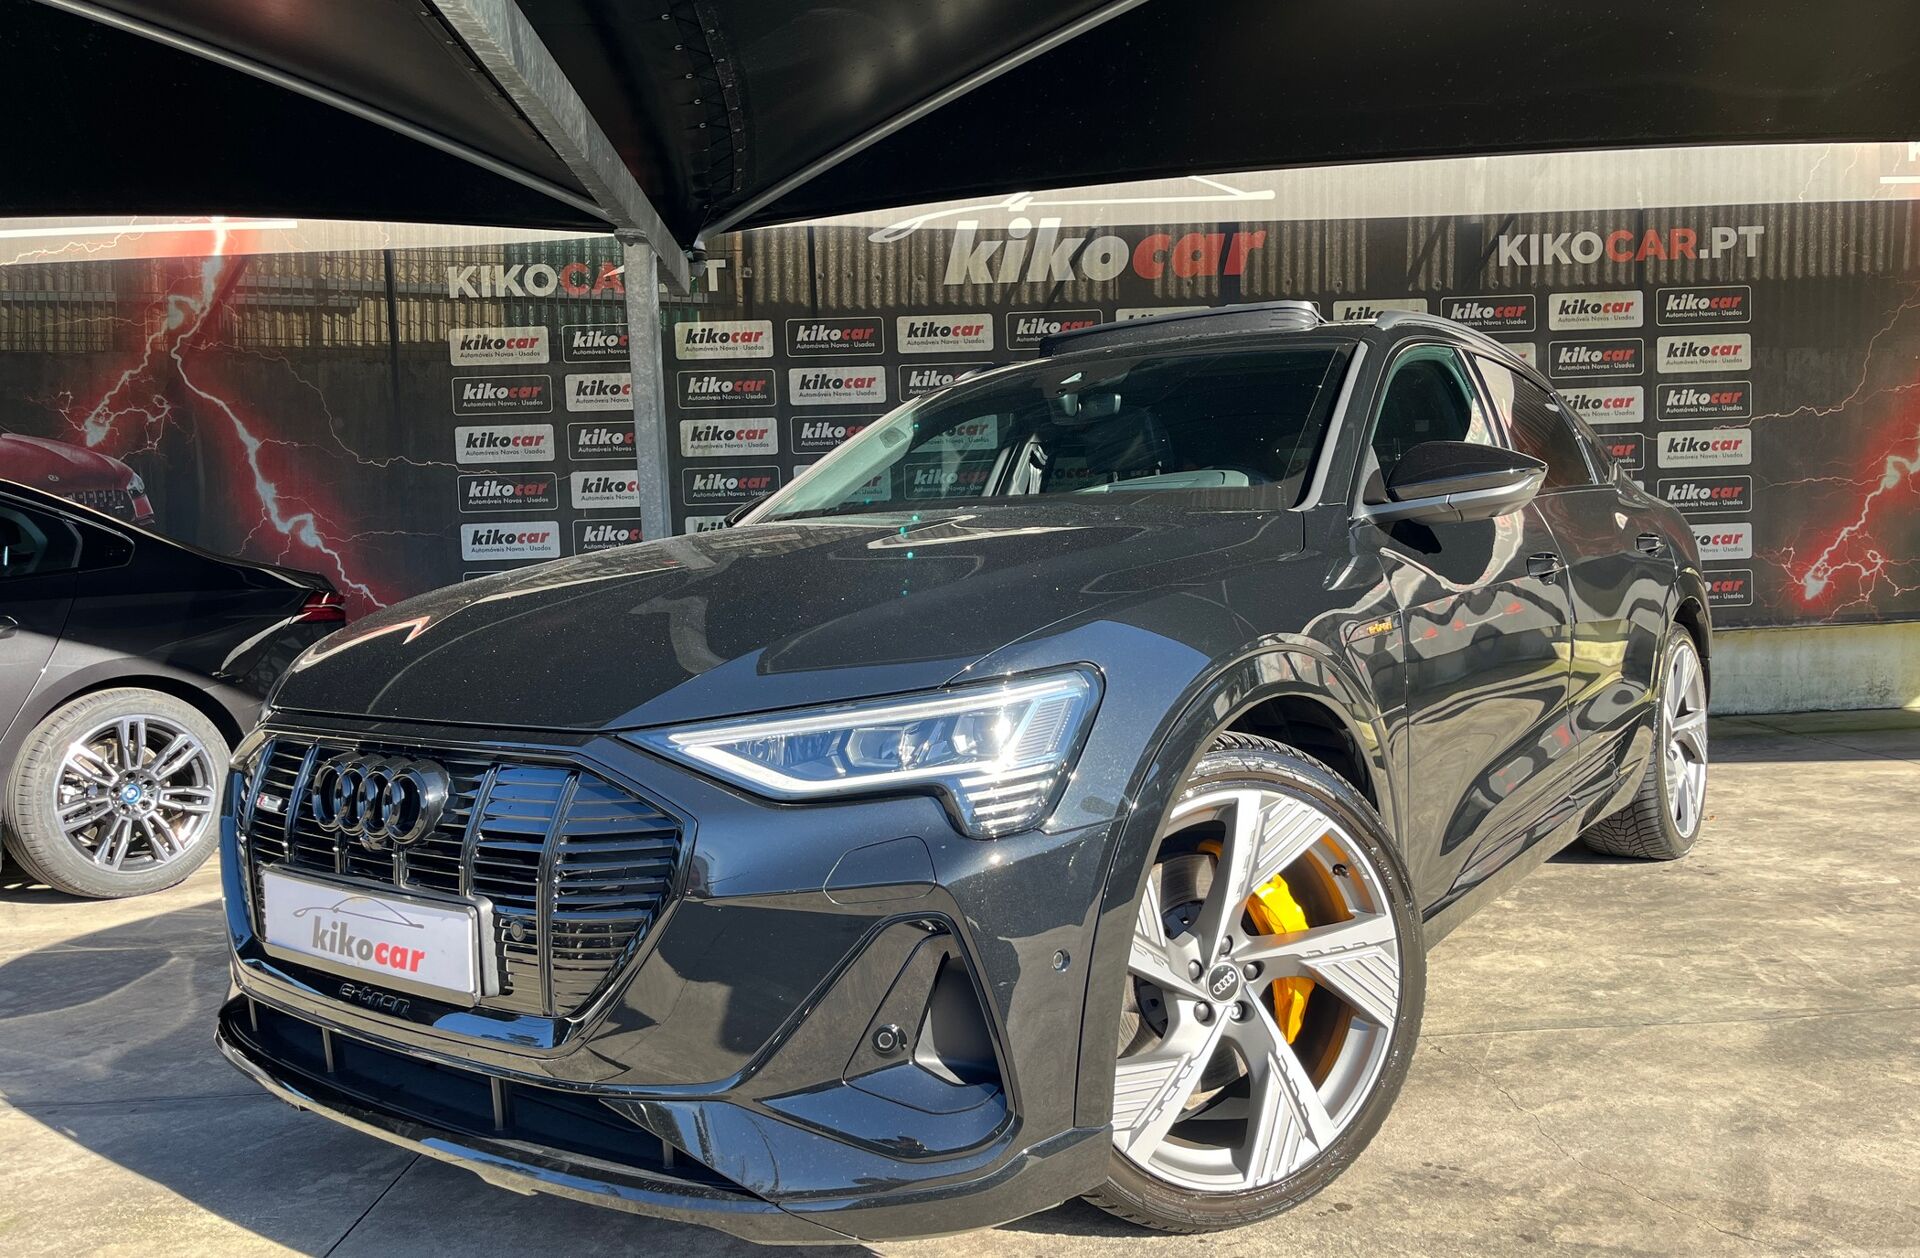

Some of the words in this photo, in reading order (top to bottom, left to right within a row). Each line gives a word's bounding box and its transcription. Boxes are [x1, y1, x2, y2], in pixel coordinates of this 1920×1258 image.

[943, 217, 1266, 285] kikocar
[1499, 225, 1764, 267] KIKOCAR.PT
[1558, 299, 1634, 315] kikocar
[1666, 293, 1742, 310] kikocar
[1451, 303, 1526, 319] kikocar
[685, 328, 763, 344] kikocar
[796, 325, 874, 341] kikocar
[907, 322, 984, 338] kikocar
[460, 334, 539, 350] kikocar
[573, 331, 628, 347] kikoc
[1559, 347, 1634, 363] kikocar
[1667, 343, 1742, 358] kikocar
[688, 377, 765, 393] kikocar
[799, 374, 876, 389] kikocar
[909, 370, 955, 387] kiko
[463, 383, 542, 400] kikocar
[576, 381, 631, 396] kikoc
[1667, 390, 1742, 406] kikocar
[578, 429, 634, 445] kikoc
[691, 426, 768, 441] kikocar
[801, 423, 863, 438] kikoc
[466, 433, 544, 448] kikocar
[1668, 438, 1742, 452] kikocar
[468, 481, 547, 497] kikocar
[581, 478, 640, 493] kikoc
[693, 474, 771, 490] kikocar
[1667, 484, 1743, 500] kikocar
[472, 530, 549, 545] kikocar
[584, 525, 643, 541] kikoc
[1696, 533, 1743, 546] ocar
[312, 916, 425, 973] kikocar
[339, 982, 410, 1014] e-tron
